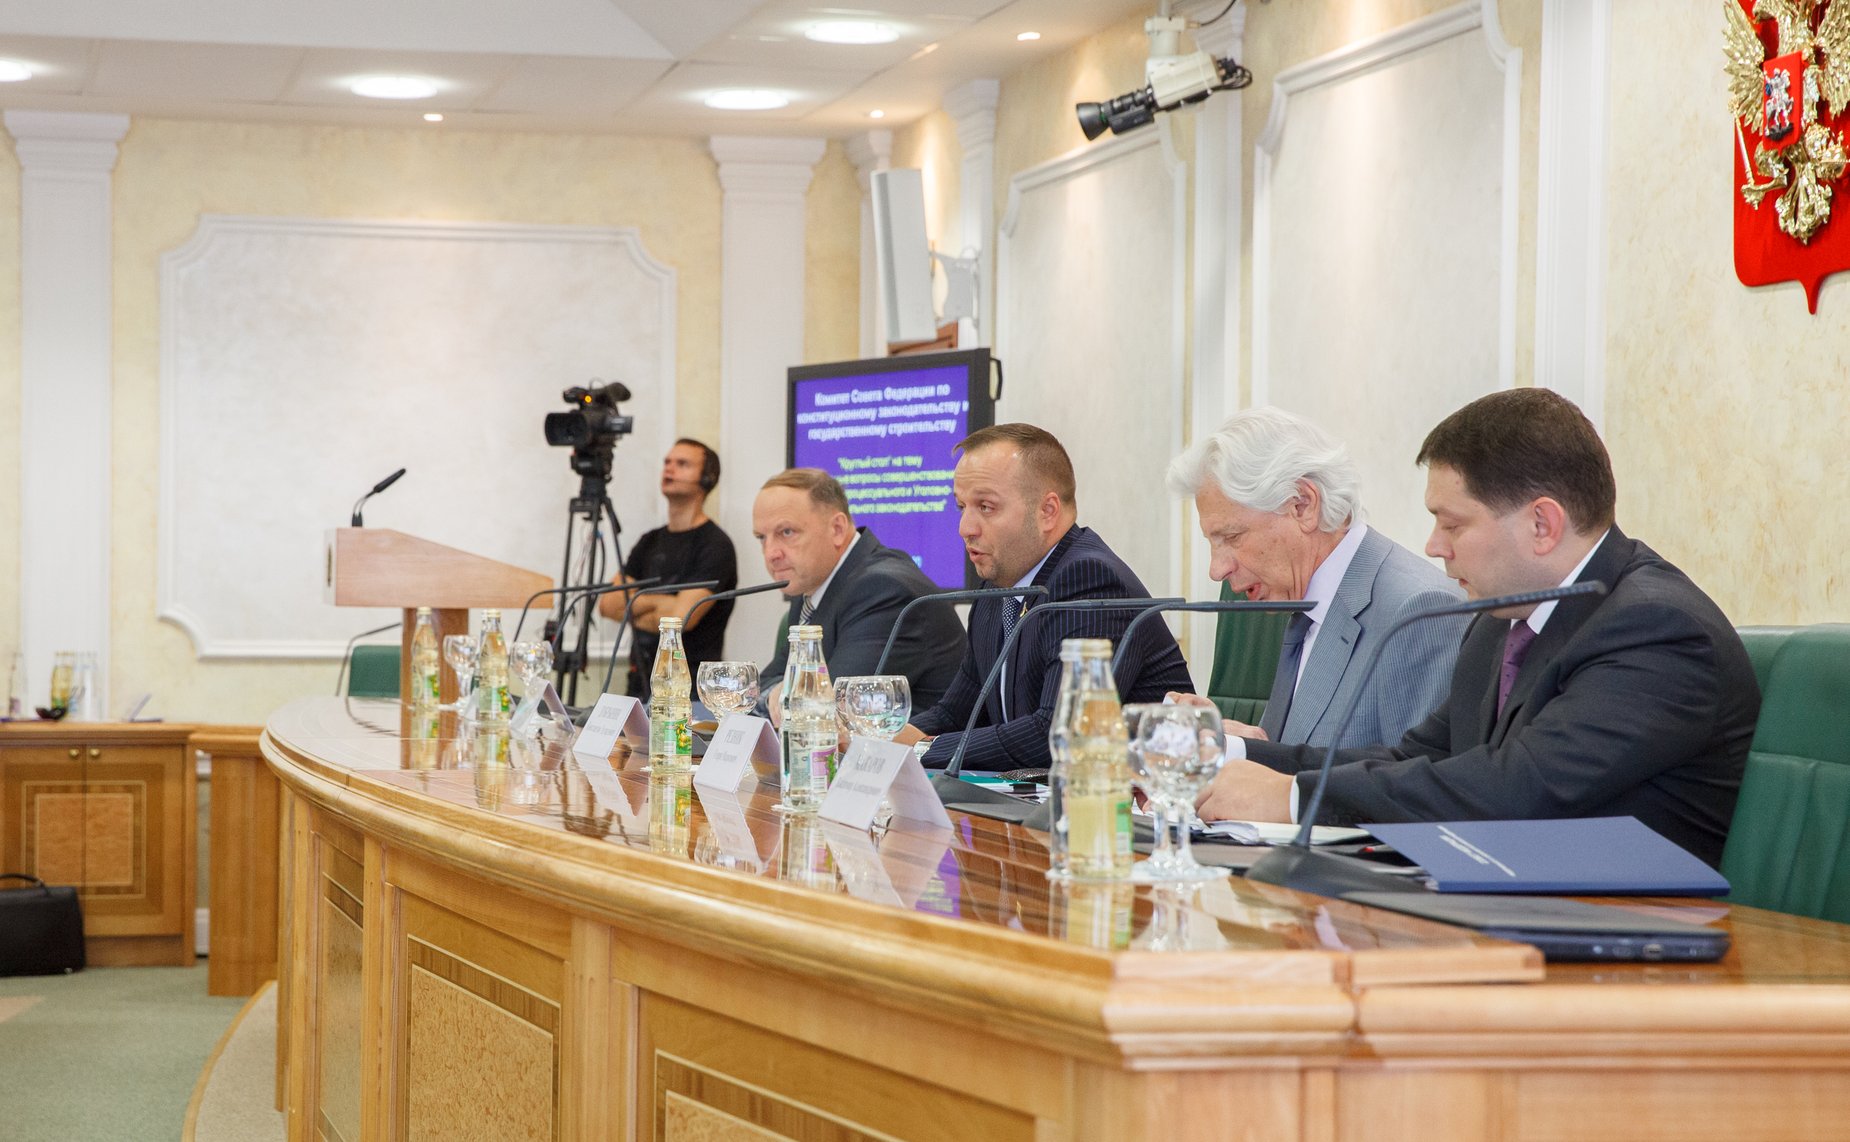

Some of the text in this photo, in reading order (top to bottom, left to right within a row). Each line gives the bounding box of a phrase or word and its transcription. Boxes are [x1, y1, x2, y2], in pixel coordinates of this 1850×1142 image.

[851, 389, 883, 403] Совета
[884, 386, 936, 400] Федерации
[937, 384, 951, 396] по
[878, 401, 961, 418] законодательству
[888, 419, 958, 437] строительству
